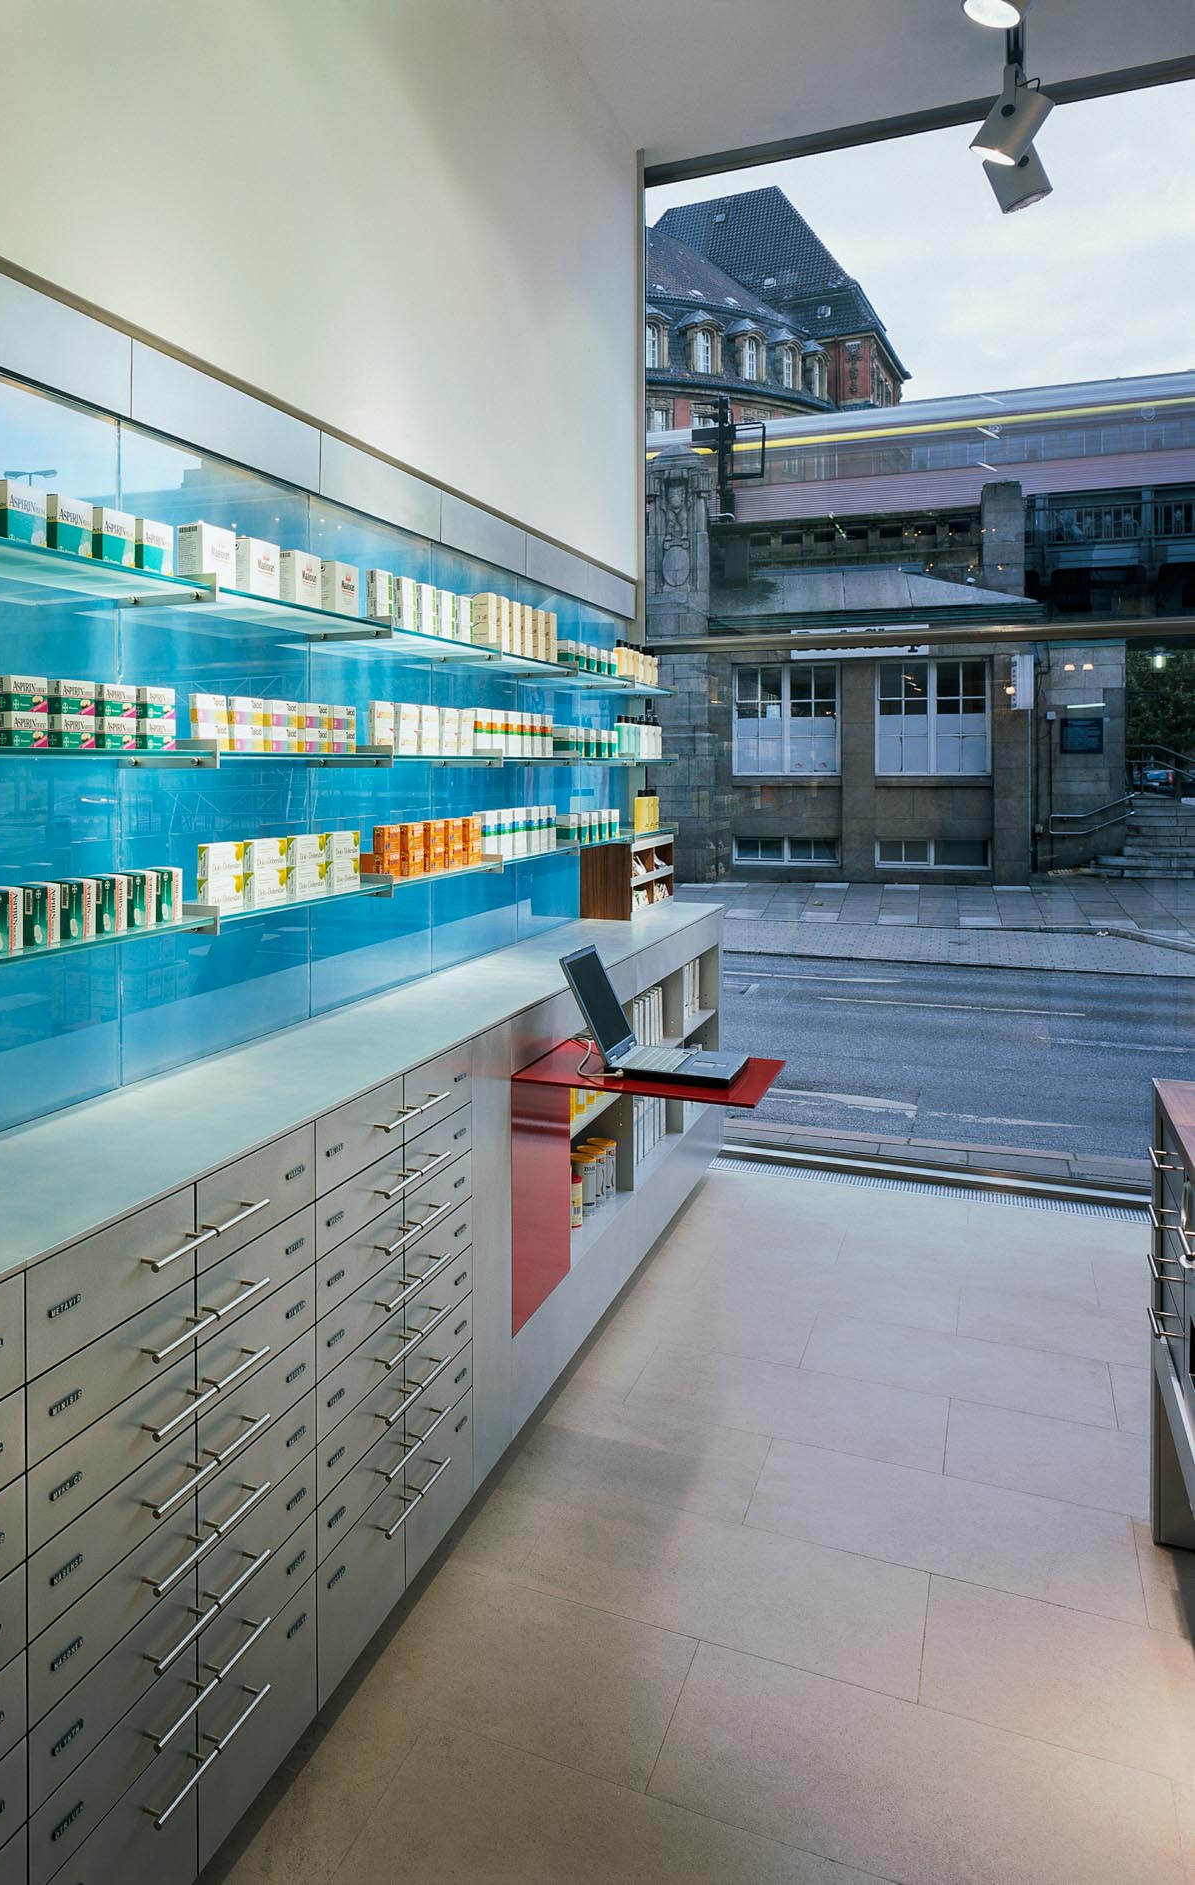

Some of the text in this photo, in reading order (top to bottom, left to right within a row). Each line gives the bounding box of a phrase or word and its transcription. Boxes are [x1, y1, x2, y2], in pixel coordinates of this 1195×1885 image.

[9, 494, 35, 512] ASPIRIN
[59, 508, 83, 525] ASPIRIN
[105, 521, 126, 536] ASPIRIN
[12, 681, 36, 693] ASPIRIN
[63, 684, 84, 697] ASPIRIN
[13, 717, 36, 728] ASPIRIN
[64, 719, 84, 731] ASPIRIN
